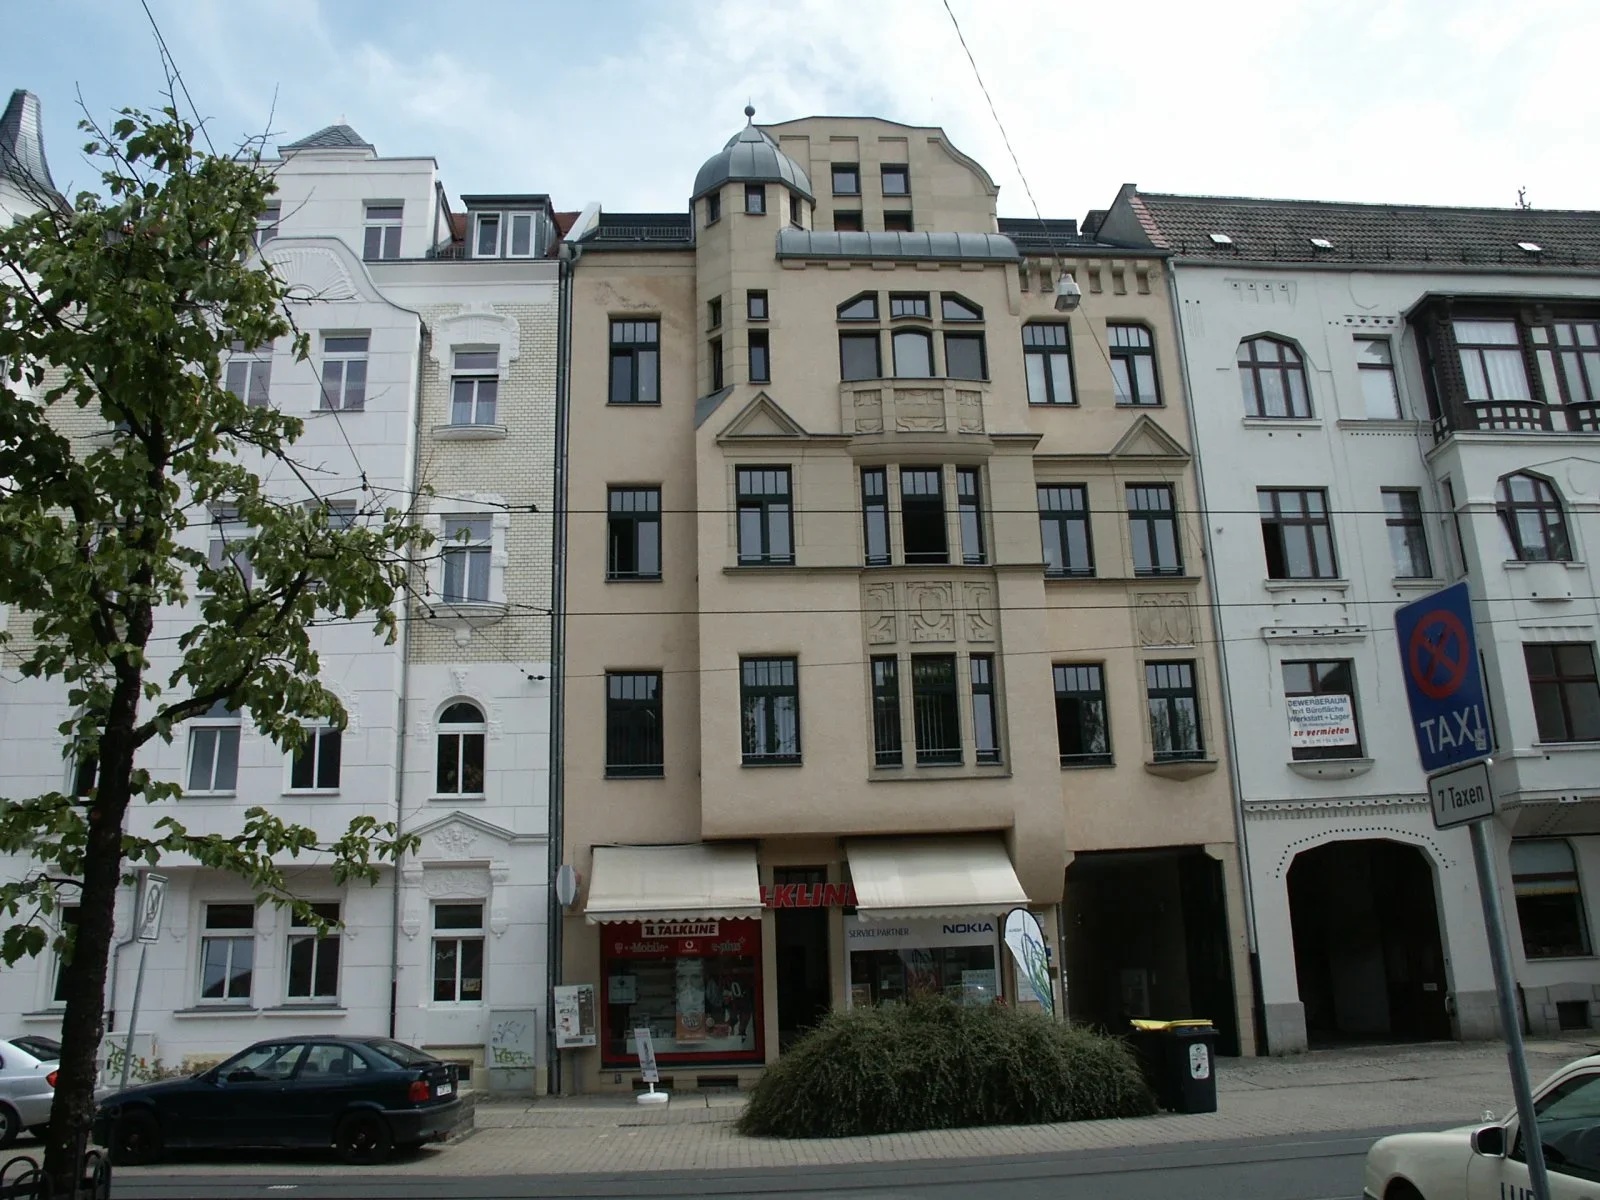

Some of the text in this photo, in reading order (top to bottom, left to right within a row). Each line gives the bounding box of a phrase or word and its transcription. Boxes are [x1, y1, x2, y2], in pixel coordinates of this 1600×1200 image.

[1306, 706, 1344, 714] Bürofläche
[1288, 714, 1323, 722] Werkstatt
[1330, 714, 1350, 722] Lager
[1306, 727, 1350, 737] vermieten
[1420, 704, 1484, 754] TAXI
[1438, 785, 1484, 812] 7 Taxen
[658, 924, 716, 936] TALKLINE
[848, 927, 909, 938] SERVICE PARTNER
[943, 923, 994, 934] NOKIA
